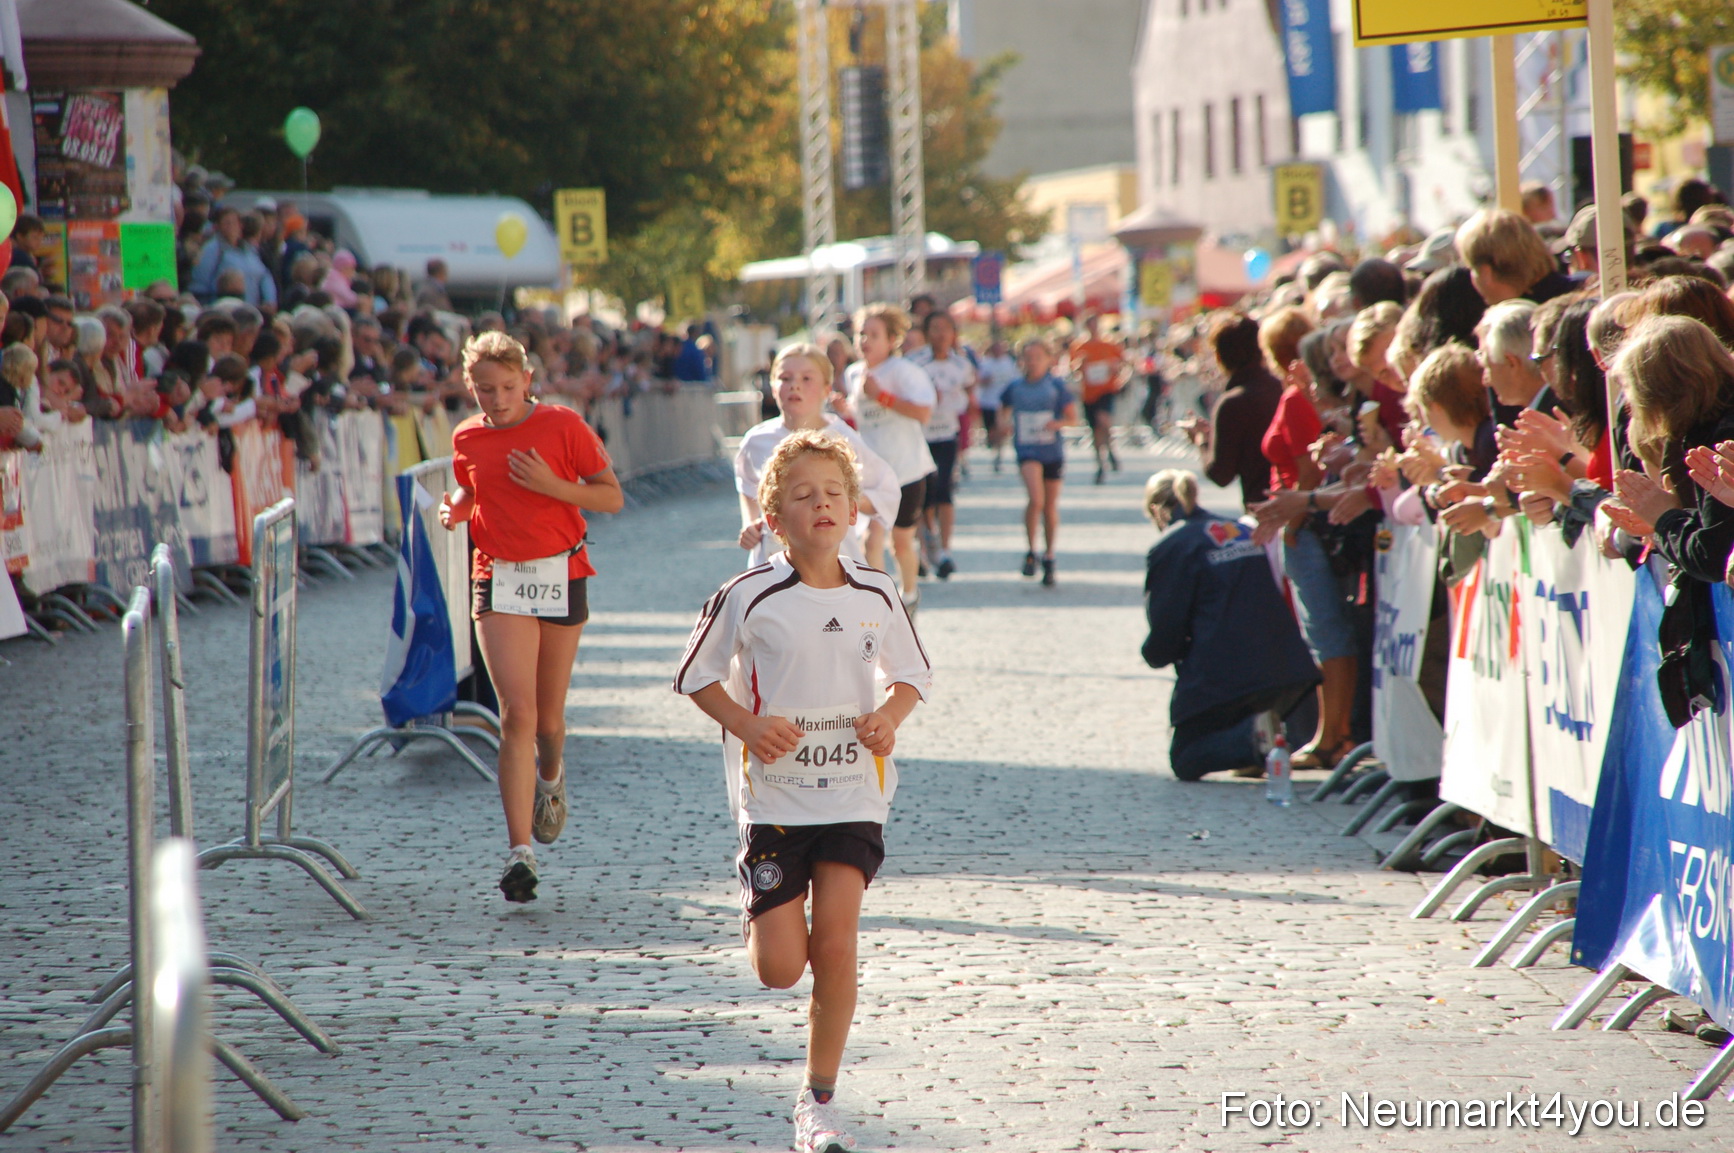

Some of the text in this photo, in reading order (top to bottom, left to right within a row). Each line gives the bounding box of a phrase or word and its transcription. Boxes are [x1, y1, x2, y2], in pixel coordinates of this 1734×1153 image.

[1289, 186, 1312, 219] B
[572, 213, 595, 246] B
[514, 562, 537, 574] Alina
[515, 584, 562, 600] 4075
[795, 742, 859, 767] 4045
